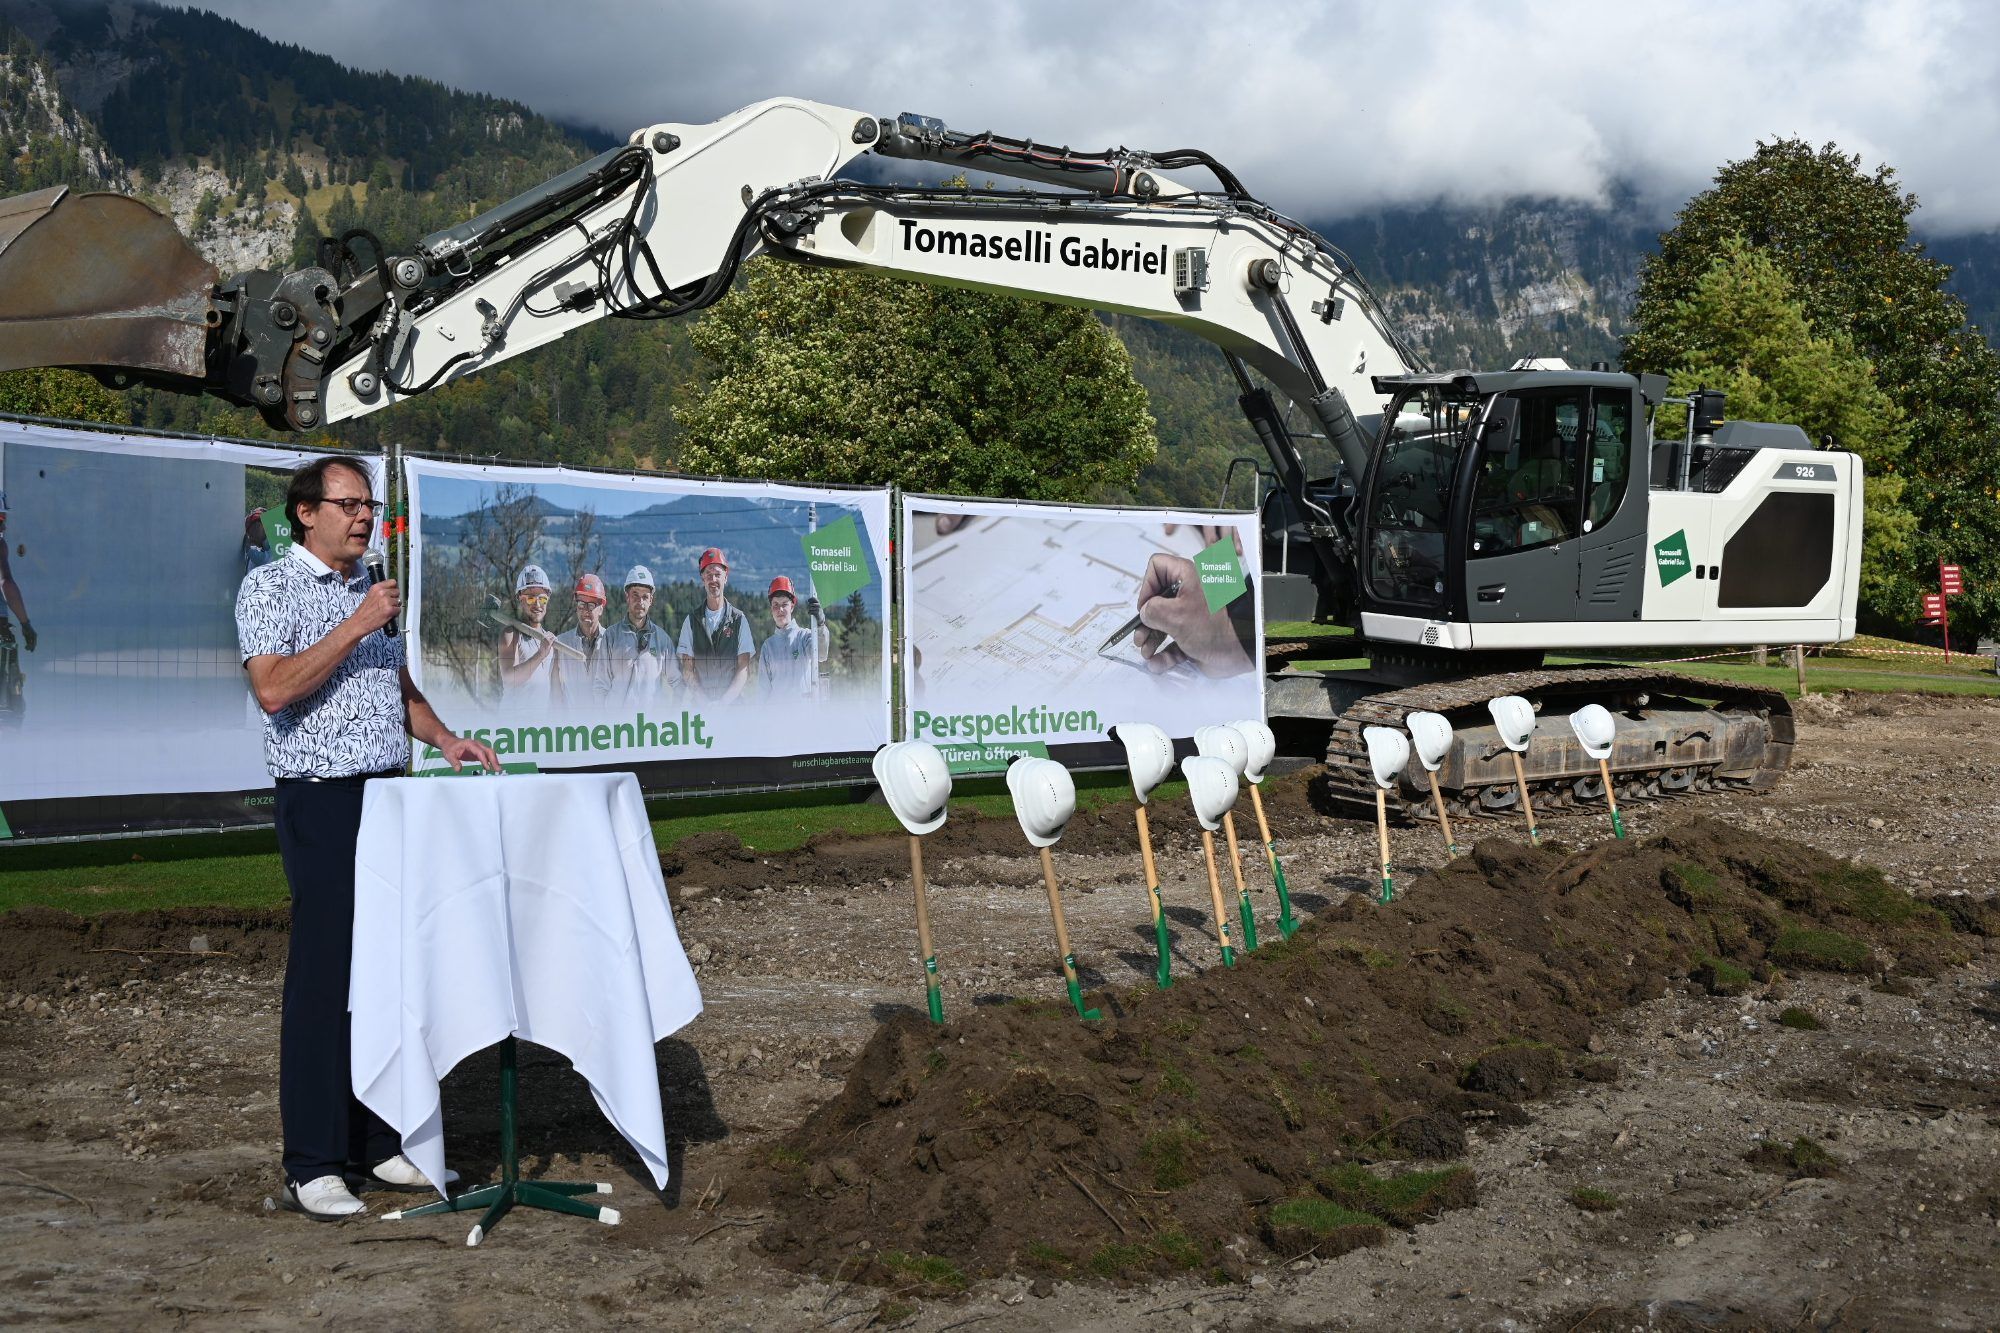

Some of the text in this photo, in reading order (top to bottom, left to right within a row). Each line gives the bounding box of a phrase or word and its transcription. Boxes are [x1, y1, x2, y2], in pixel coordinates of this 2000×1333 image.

[899, 219, 1168, 275] Tomaselli Gabriel
[1795, 466, 1815, 478] 926
[810, 545, 851, 557] Tomaselli
[811, 560, 858, 572] Gabriel Bau
[1200, 562, 1232, 571] Tomaselli
[1658, 558, 1676, 566] Gabriel
[1201, 574, 1237, 584] Gabriel Bau
[913, 704, 1104, 744] Perspektiven,
[423, 711, 714, 760] sammenhalt,
[940, 748, 981, 763] Türen
